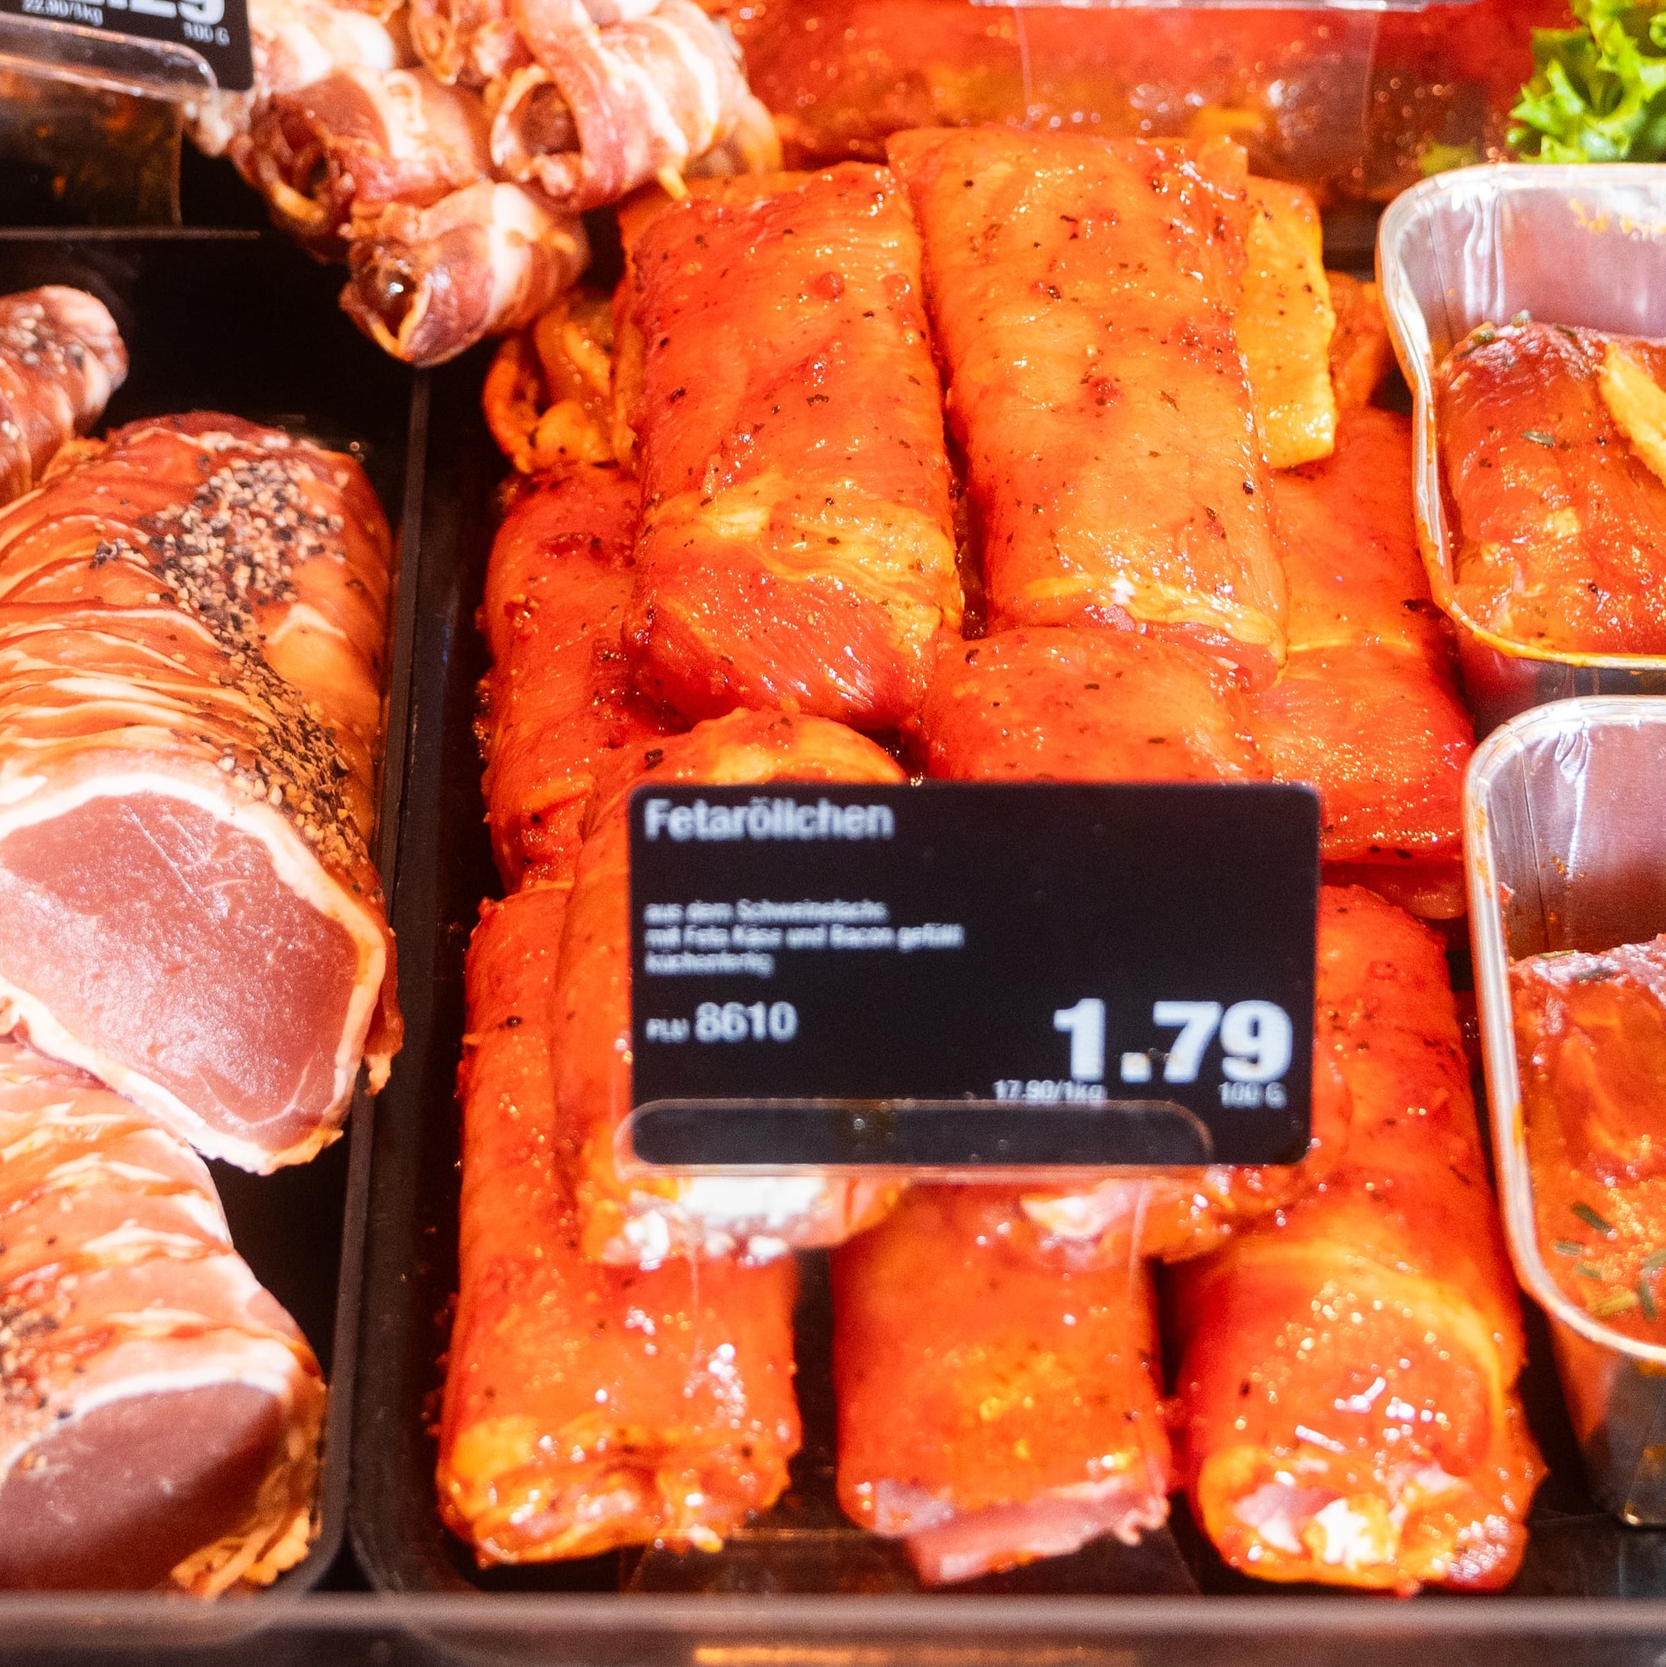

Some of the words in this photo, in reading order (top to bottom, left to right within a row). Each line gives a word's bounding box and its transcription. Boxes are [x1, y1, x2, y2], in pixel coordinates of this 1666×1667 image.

[645, 798, 895, 841] Fetaröllchen
[694, 1001, 798, 1043] 8610
[1054, 998, 1293, 1082] 1.79
